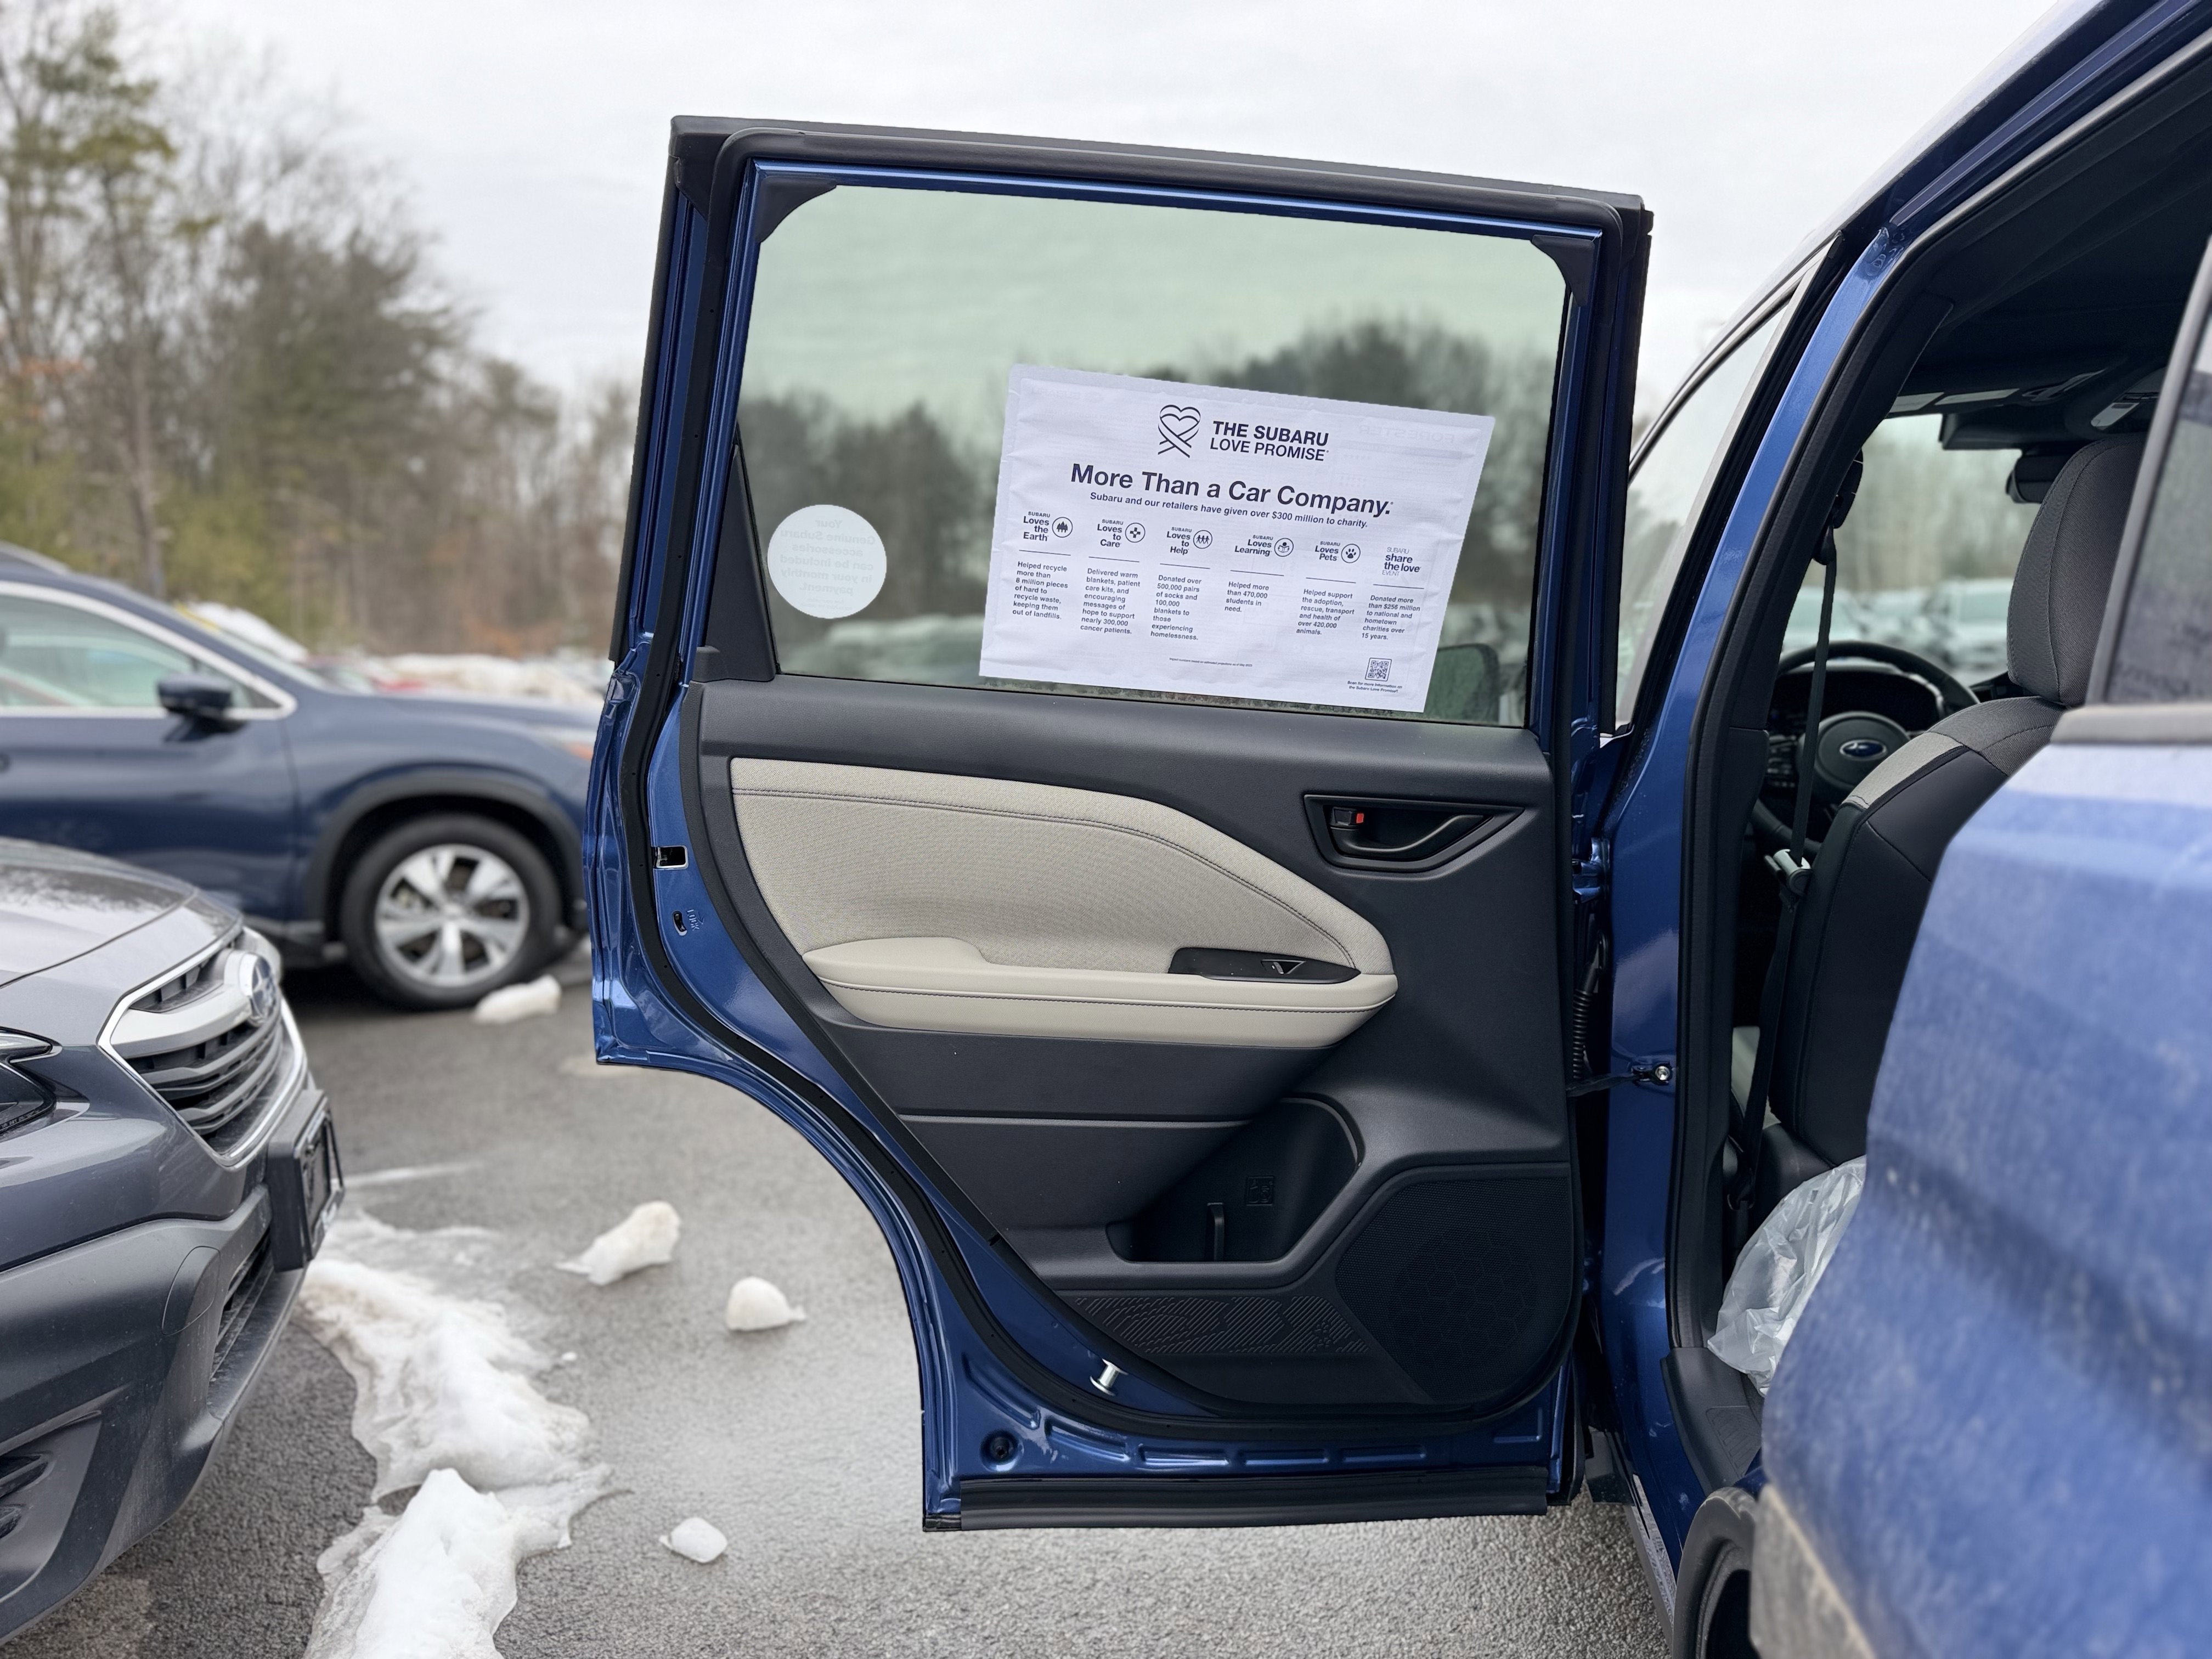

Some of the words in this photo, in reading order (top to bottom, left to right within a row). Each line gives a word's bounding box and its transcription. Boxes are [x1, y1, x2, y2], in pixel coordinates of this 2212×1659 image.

[1212, 420, 1249, 438] THE
[1253, 425, 1329, 447] SUBARU
[1210, 437, 1251, 454] LOVE
[1070, 463, 1133, 489] More
[1142, 471, 1199, 496] Than
[1206, 483, 1221, 499] a
[1228, 481, 1271, 503] Car
[1090, 492, 1123, 503] Subaru
[1125, 497, 1143, 505] and
[1162, 501, 1199, 511] retailers
[1200, 504, 1222, 514] have
[1223, 506, 1248, 516] given
[1271, 511, 1293, 521] $300
[1294, 514, 1324, 524] million
[1337, 518, 1368, 529] charity.
[1023, 516, 1049, 526] Loves
[1034, 525, 1049, 534] the
[1097, 523, 1122, 533] Loves
[1023, 532, 1048, 542] Earth
[1112, 533, 1121, 541] to
[1166, 531, 1191, 540] Loves
[1100, 539, 1120, 548] Care
[1247, 539, 1272, 548] Loves
[1170, 545, 1188, 556] Help
[1234, 545, 1271, 557] Learning
[1314, 545, 1339, 554] Loves
[1386, 546, 1410, 555] SUBARU
[1319, 552, 1338, 562] Pets
[1385, 553, 1413, 563] share
[1017, 561, 1042, 570] Helped
[1384, 561, 1400, 571] the
[1400, 563, 1420, 573] love
[1087, 568, 1119, 577] Delivered
[1086, 576, 1116, 586] blankets,
[1158, 574, 1186, 583] Donated
[1046, 580, 1068, 589] pieces
[1156, 583, 1182, 591] 500,000
[1228, 581, 1251, 590] Helped
[1101, 585, 1115, 594] kits,
[1303, 588, 1327, 597] Helped
[1084, 594, 1126, 603] encouraging
[1243, 590, 1268, 599] 470,000
[1040, 596, 1062, 605] waste,
[1155, 599, 1180, 607] 100,000
[1226, 597, 1254, 606] students
[1313, 598, 1344, 607] adoption,
[1013, 600, 1040, 611] keeping
[1083, 601, 1117, 610] messages
[1034, 611, 1062, 619] landfills.
[1082, 608, 1099, 617] hope
[1154, 607, 1182, 616] blankets
[1325, 607, 1355, 616] transport
[1081, 617, 1102, 625] nearly
[1103, 618, 1128, 627] 300,000
[1364, 617, 1397, 625] hometown
[1152, 624, 1193, 634] experiencing
[1150, 630, 1199, 641] homelessness.
[687, 909, 700, 932] LOCK
